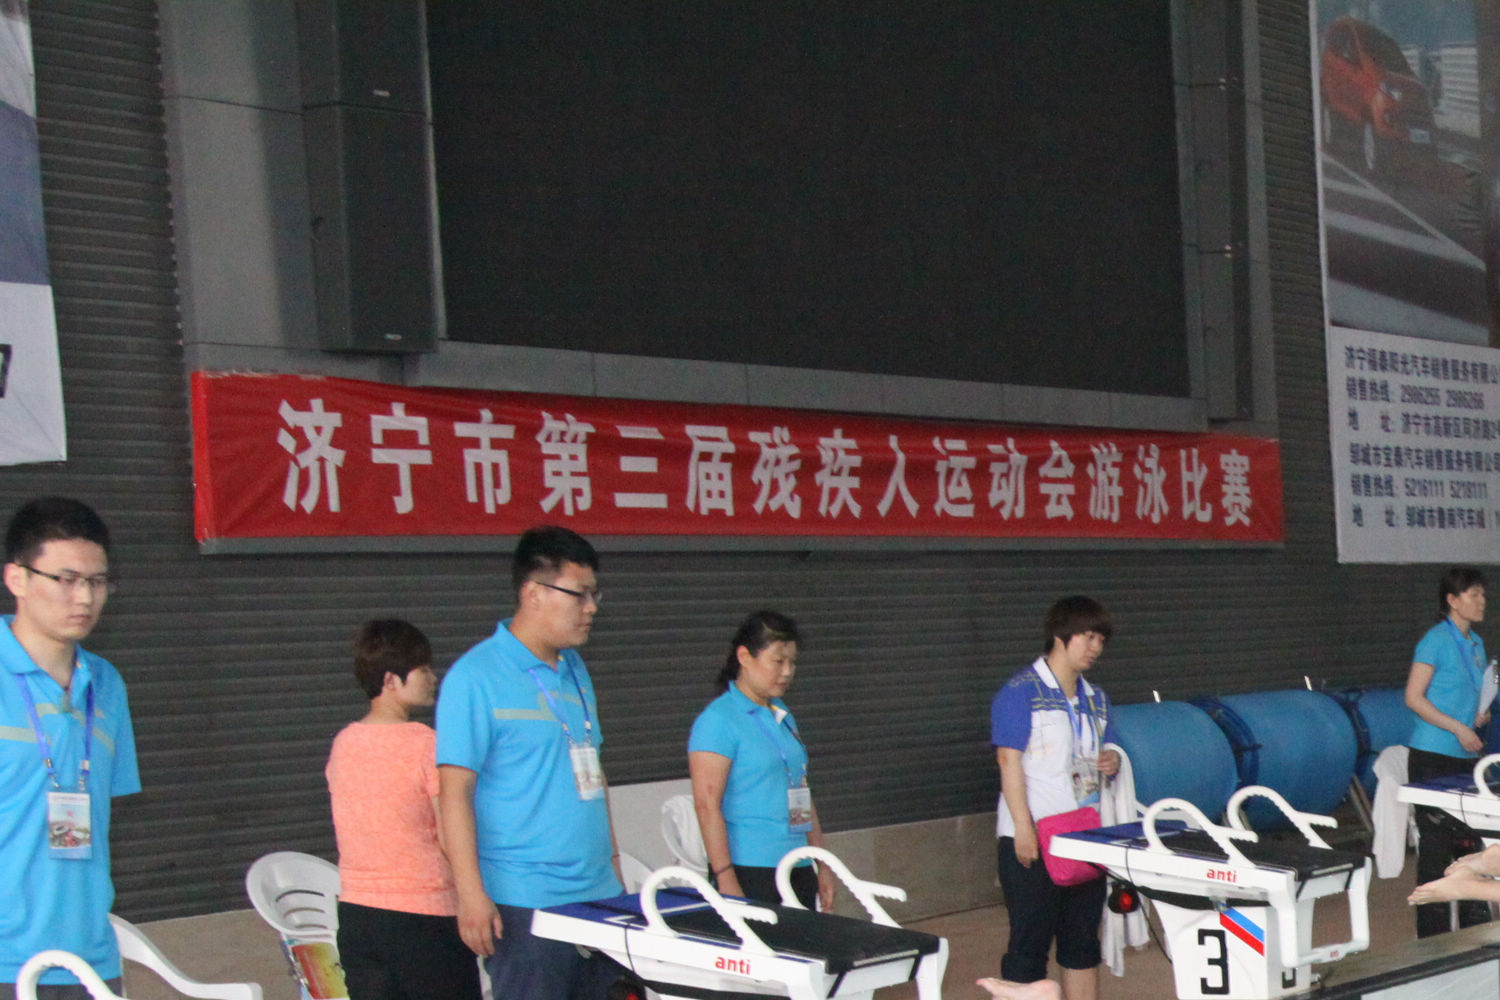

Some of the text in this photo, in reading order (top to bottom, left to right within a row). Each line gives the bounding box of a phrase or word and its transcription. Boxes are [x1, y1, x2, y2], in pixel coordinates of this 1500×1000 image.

[276, 397, 1252, 528] 济宁市第三届残疾人运动会游泳比赛
[1206, 868, 1237, 883] anti
[714, 955, 751, 975] anti
[1198, 928, 1230, 995] 3
